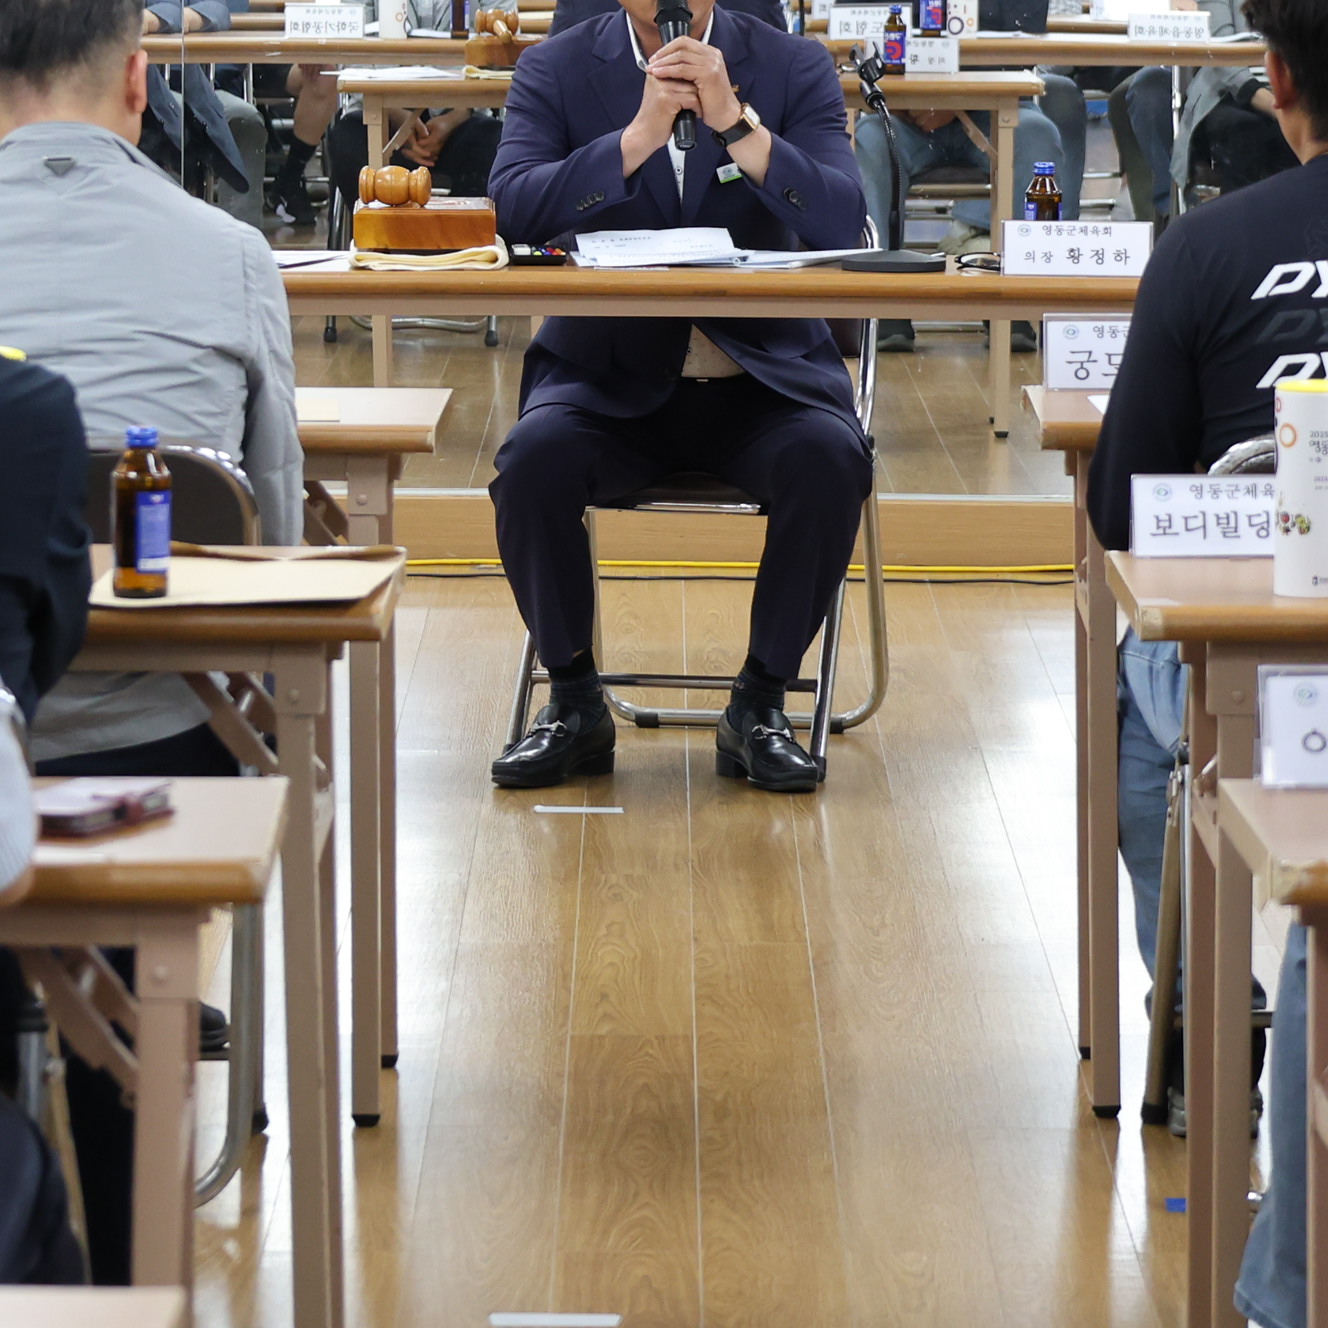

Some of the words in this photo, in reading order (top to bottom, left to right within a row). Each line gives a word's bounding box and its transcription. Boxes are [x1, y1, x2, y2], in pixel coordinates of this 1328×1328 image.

[1041, 223, 1113, 238] 영동군체육회
[1188, 481, 1275, 501] 영동군체육
[1148, 509, 1271, 542] 보디빌딩
